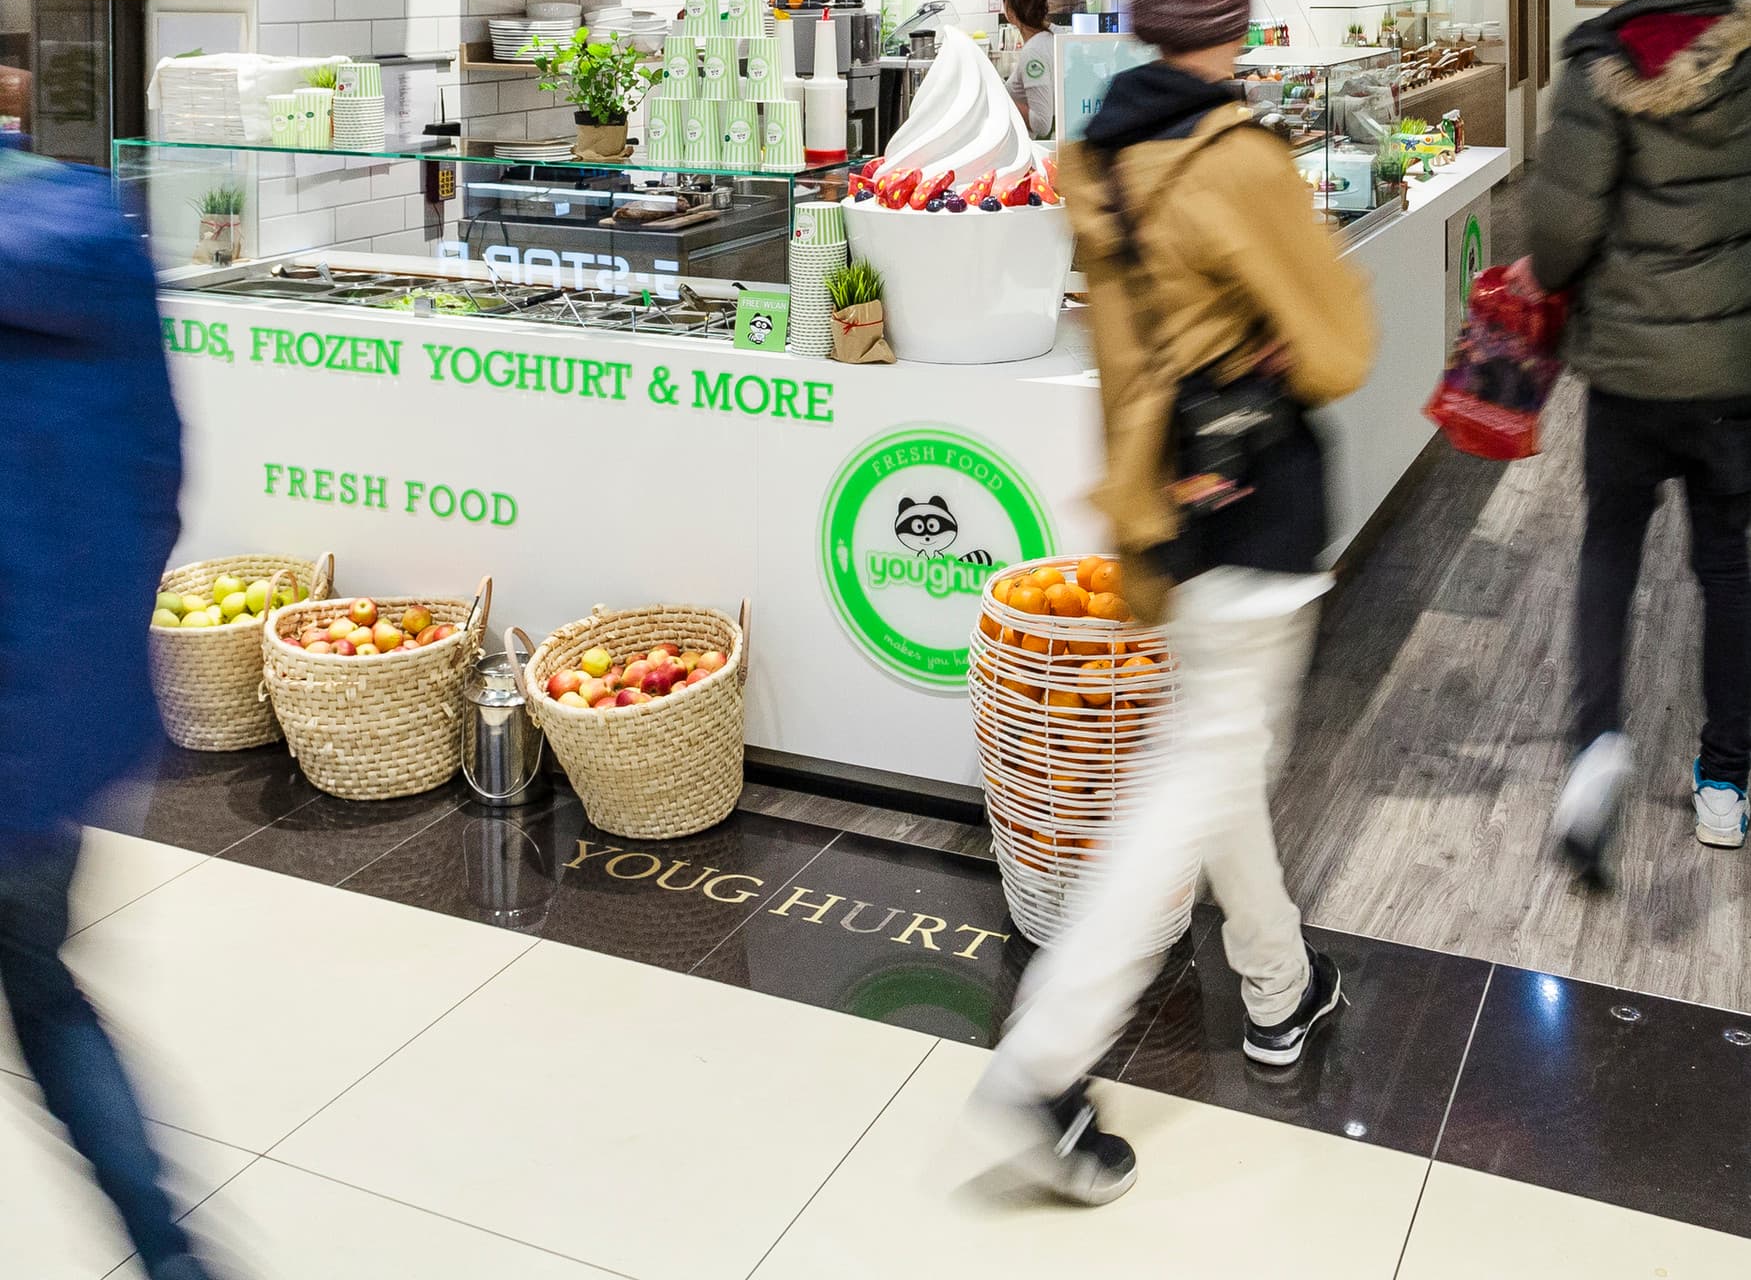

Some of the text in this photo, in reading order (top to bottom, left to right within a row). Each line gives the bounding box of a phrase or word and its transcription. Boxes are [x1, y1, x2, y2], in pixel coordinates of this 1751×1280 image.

[742, 297, 787, 311] FREE WLAN
[249, 327, 402, 377] FROZEN
[423, 343, 632, 401] YOGHURT
[647, 366, 680, 406] &
[691, 370, 836, 423] MORE
[872, 446, 1004, 492] FRESH FOOD
[263, 463, 518, 527] FRESH FOOD
[868, 551, 1003, 597] youghu
[883, 633, 921, 660] makes
[927, 655, 949, 670] you
